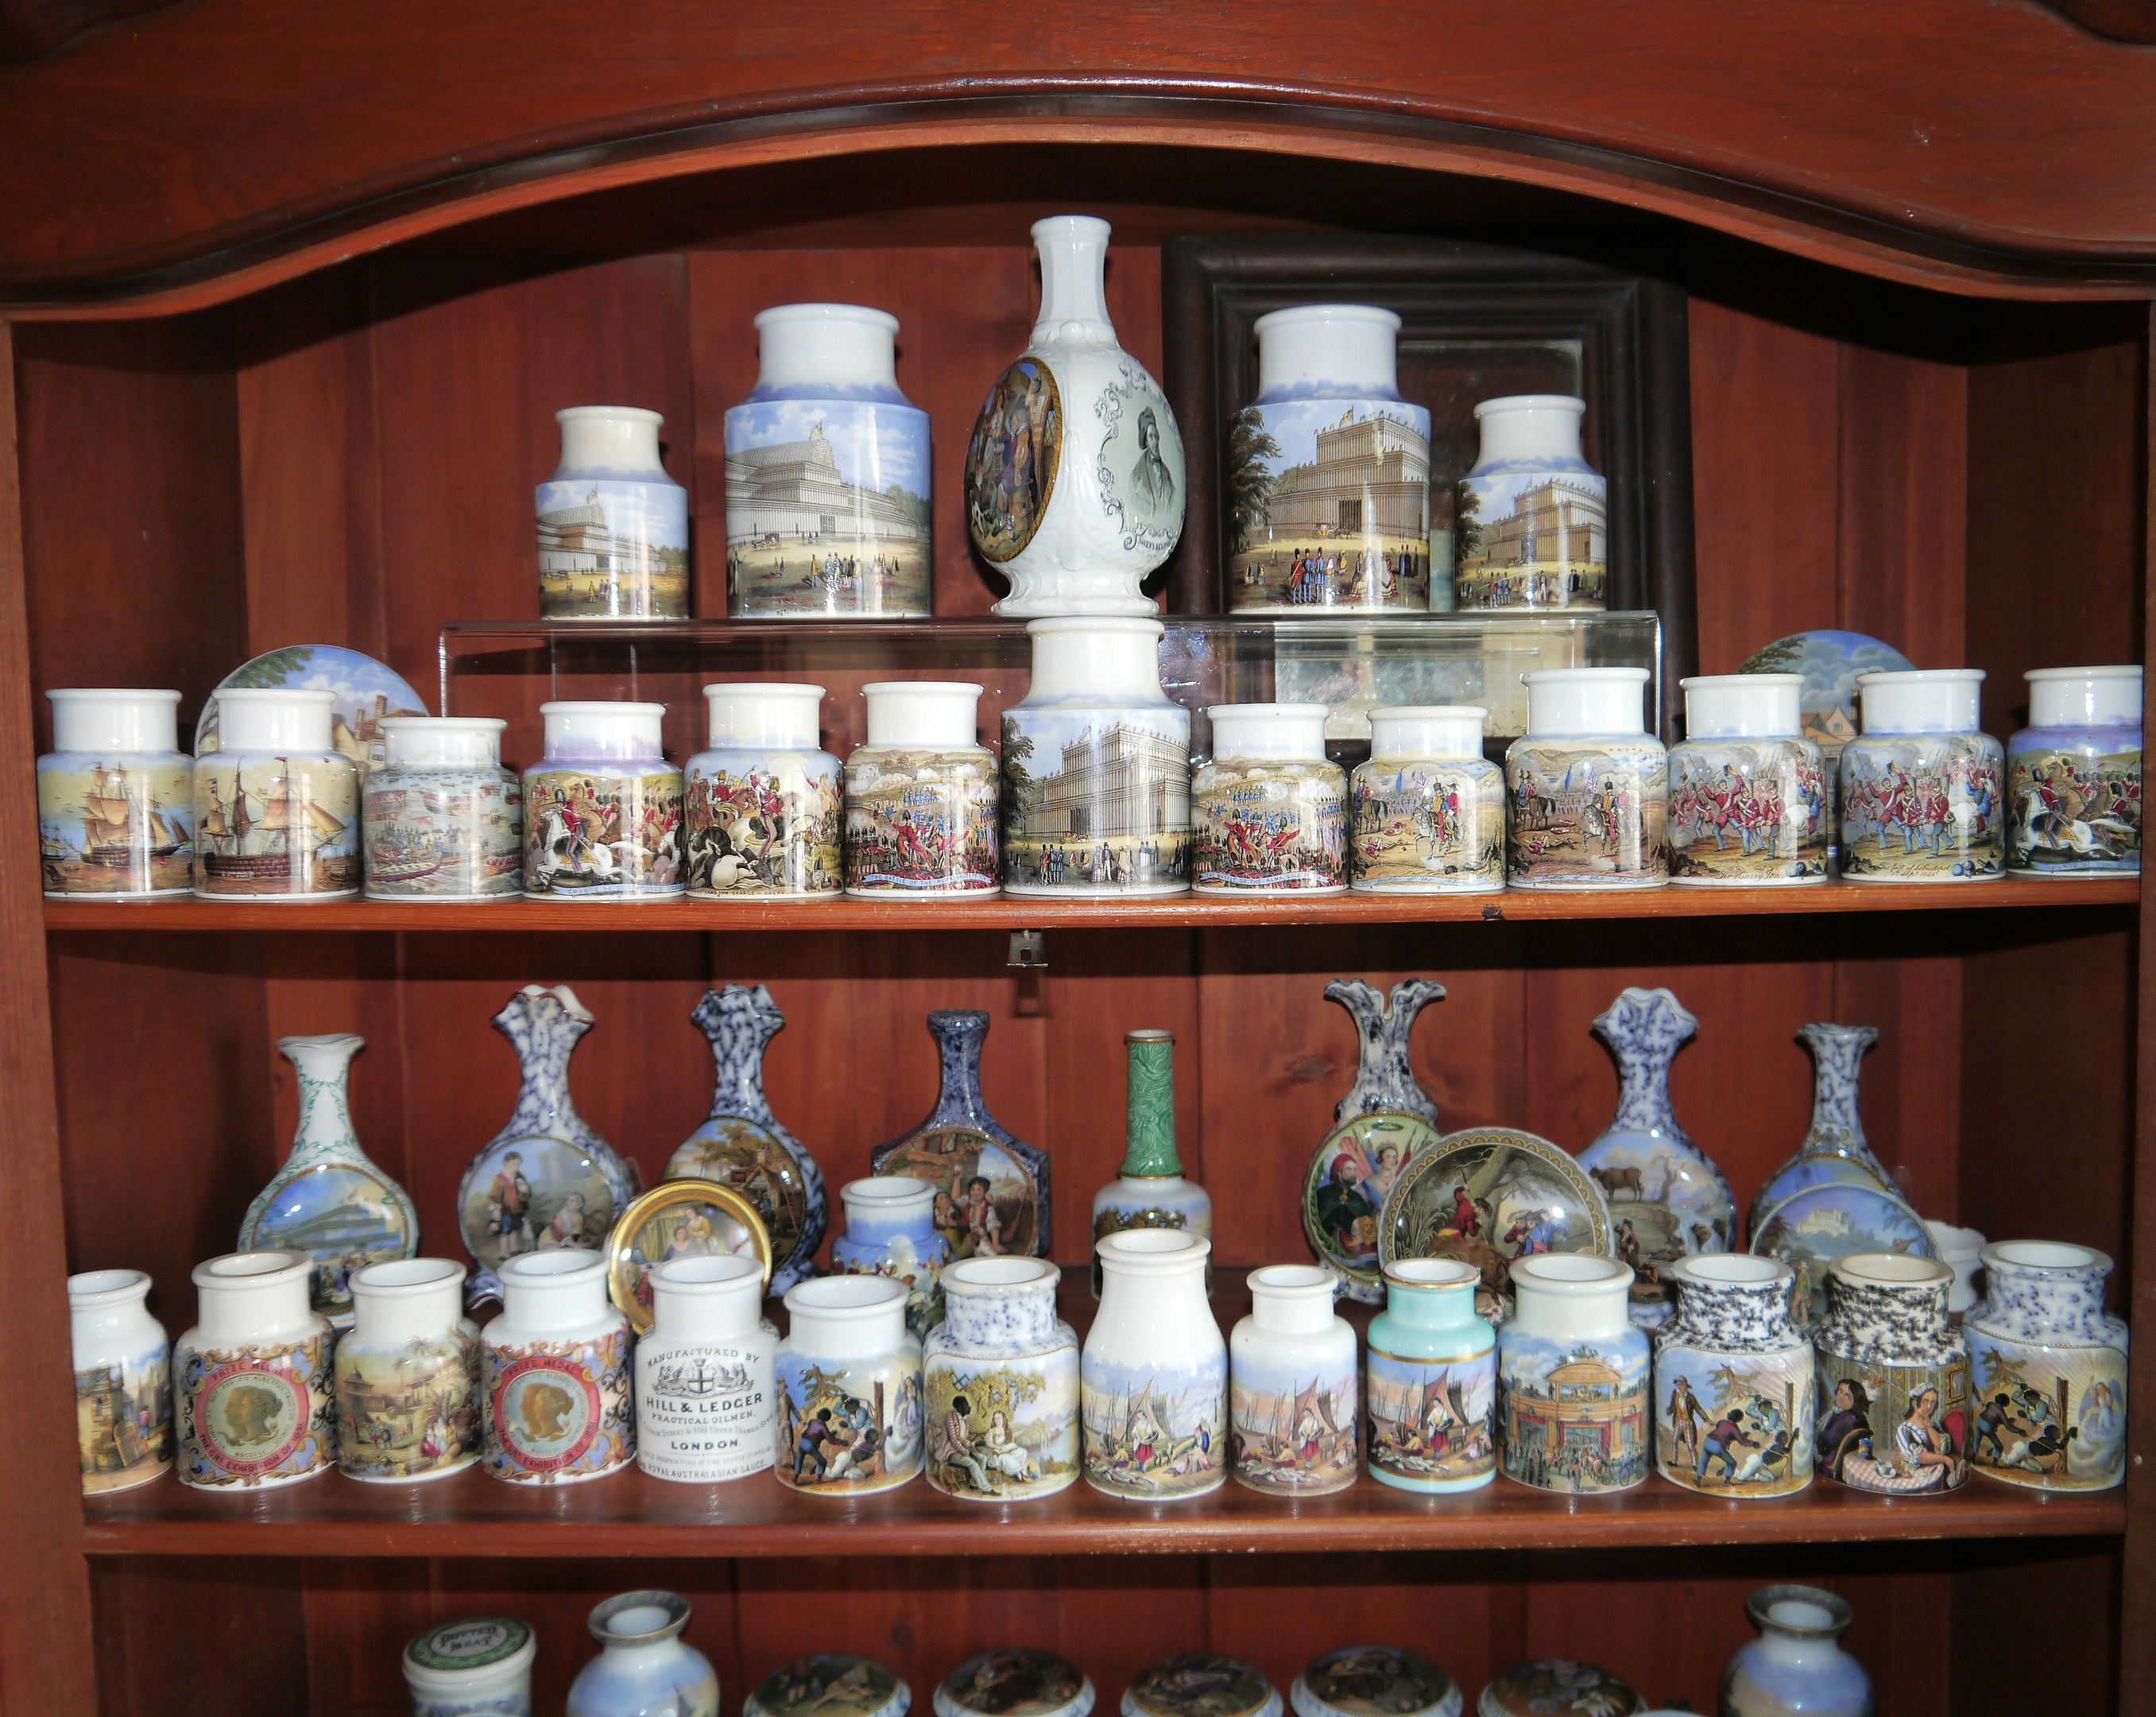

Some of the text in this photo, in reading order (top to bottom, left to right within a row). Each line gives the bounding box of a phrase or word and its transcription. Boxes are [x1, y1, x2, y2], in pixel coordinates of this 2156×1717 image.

[508, 1359, 574, 1377] PRIZE MEDAL
[745, 1353, 760, 1363] BY
[211, 1362, 246, 1382] PRIZE
[646, 1397, 677, 1413] HILL
[680, 1402, 694, 1413] &
[699, 1393, 763, 1413] LEDGER
[652, 1413, 709, 1424] PRACTICAL
[712, 1410, 756, 1424] OILMEN.
[199, 1434, 210, 1448] THE
[226, 1454, 280, 1472] EXHIBITION
[281, 1444, 291, 1455] OF
[499, 1429, 509, 1444] THE
[524, 1452, 574, 1469] EXHIBITION
[575, 1442, 584, 1452] OF
[672, 1438, 741, 1451] LONDON.
[648, 1459, 768, 1479] ROYAL AUSTRALASIAN SAUCE.
